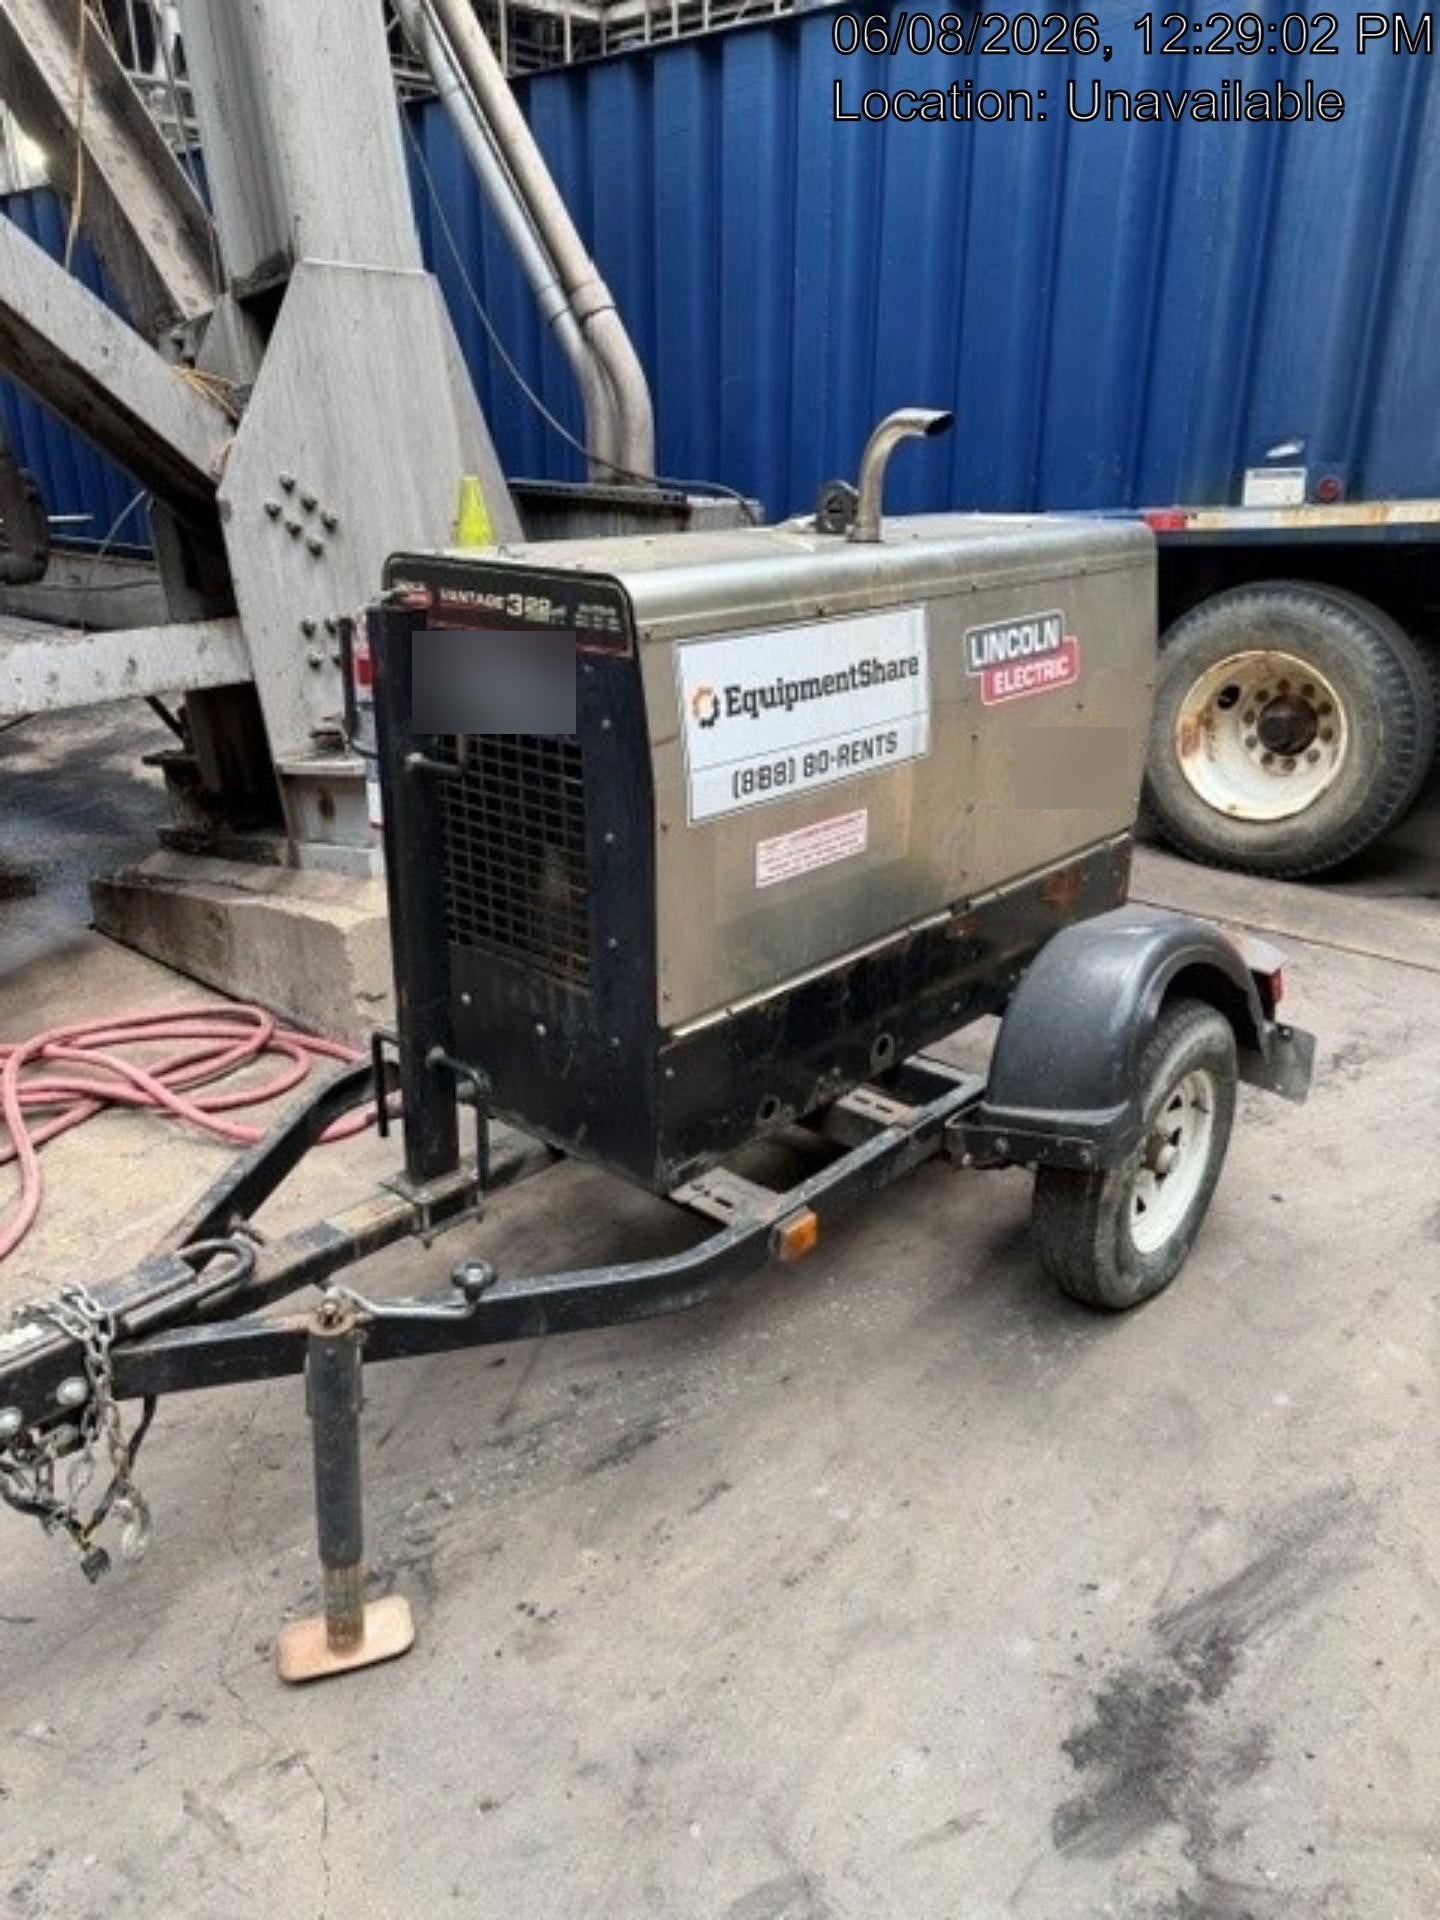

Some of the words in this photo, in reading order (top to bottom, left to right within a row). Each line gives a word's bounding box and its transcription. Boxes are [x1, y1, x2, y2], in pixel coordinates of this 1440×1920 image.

[970, 618, 1060, 667] LINCOLN
[723, 655, 919, 718] EquipmentShare
[993, 656, 1069, 693] ELECTRIC
[732, 760, 796, 798] (888)
[803, 732, 898, 778] 80-RENTS
